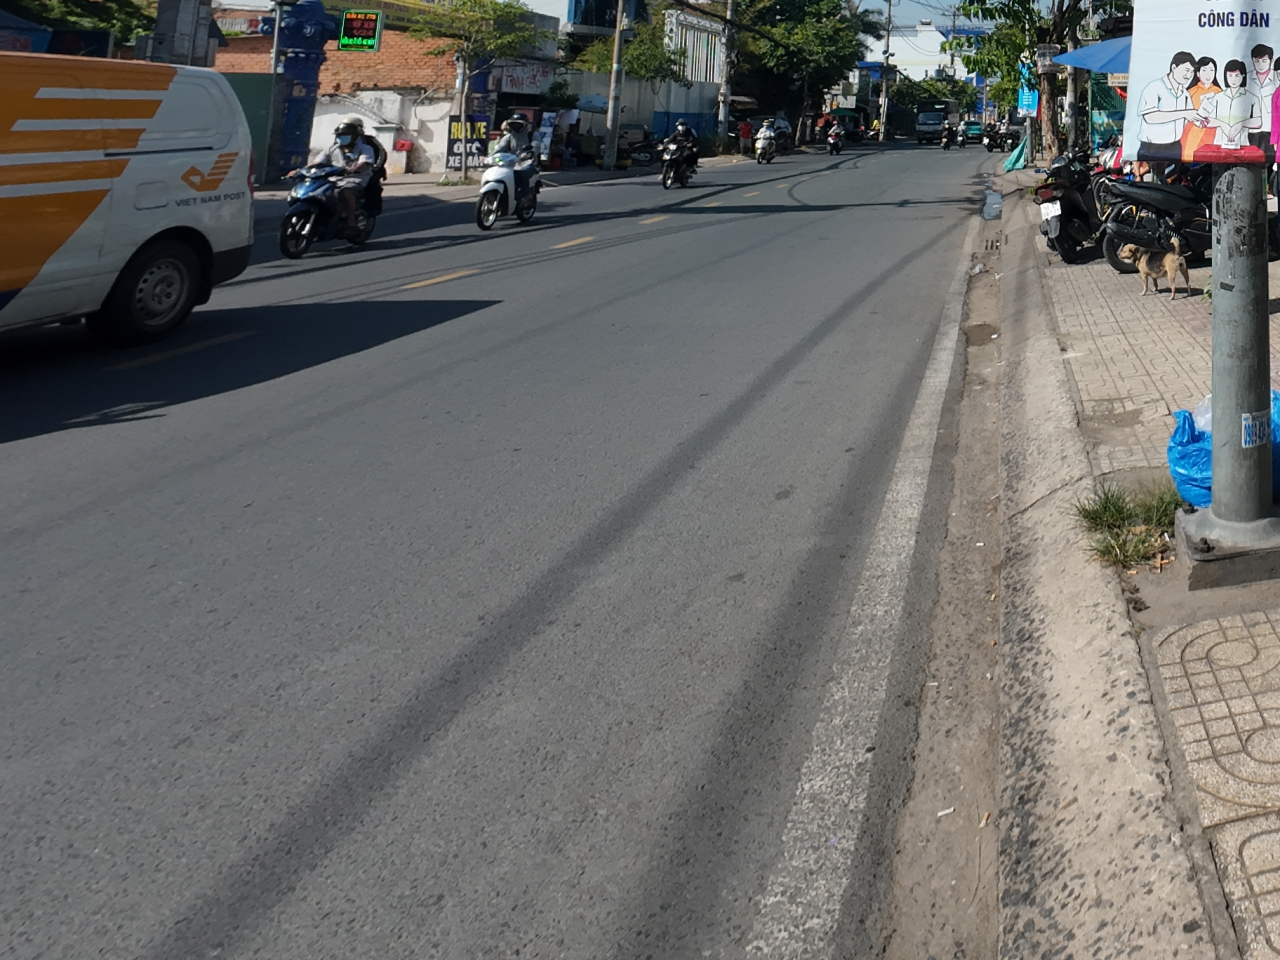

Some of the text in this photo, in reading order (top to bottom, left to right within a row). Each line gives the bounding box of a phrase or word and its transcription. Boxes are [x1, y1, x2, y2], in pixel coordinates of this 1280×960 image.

[1198, 8, 1270, 28] CÔNG DÂN
[475, 122, 486, 138] XE
[448, 155, 461, 167] XE
[175, 191, 246, 207] VIET NAM POST
